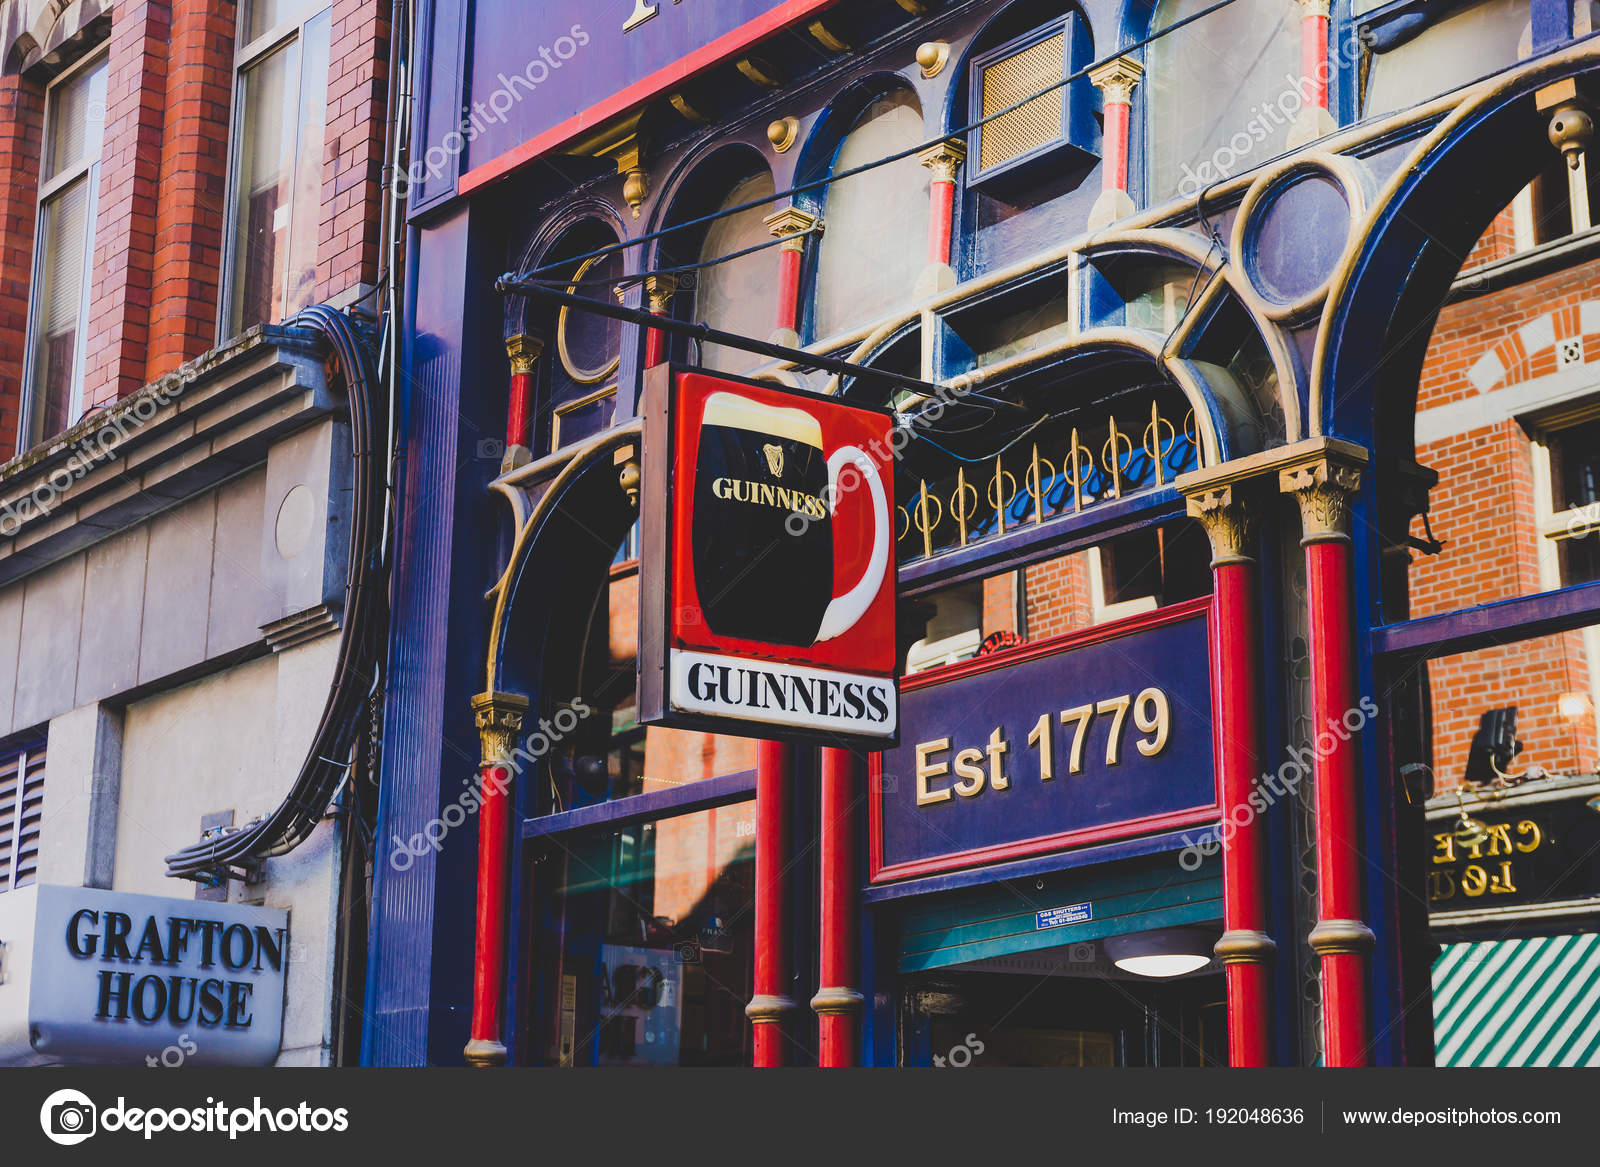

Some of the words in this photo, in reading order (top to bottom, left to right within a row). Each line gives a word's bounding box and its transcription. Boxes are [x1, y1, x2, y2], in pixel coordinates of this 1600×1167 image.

[712, 477, 826, 520] GUINNESS
[687, 662, 889, 722] GUINNESS
[915, 726, 1009, 807] Est
[1027, 687, 1170, 781] 1779
[66, 908, 287, 972] GRAFTON
[95, 969, 254, 1028] HOUSE
